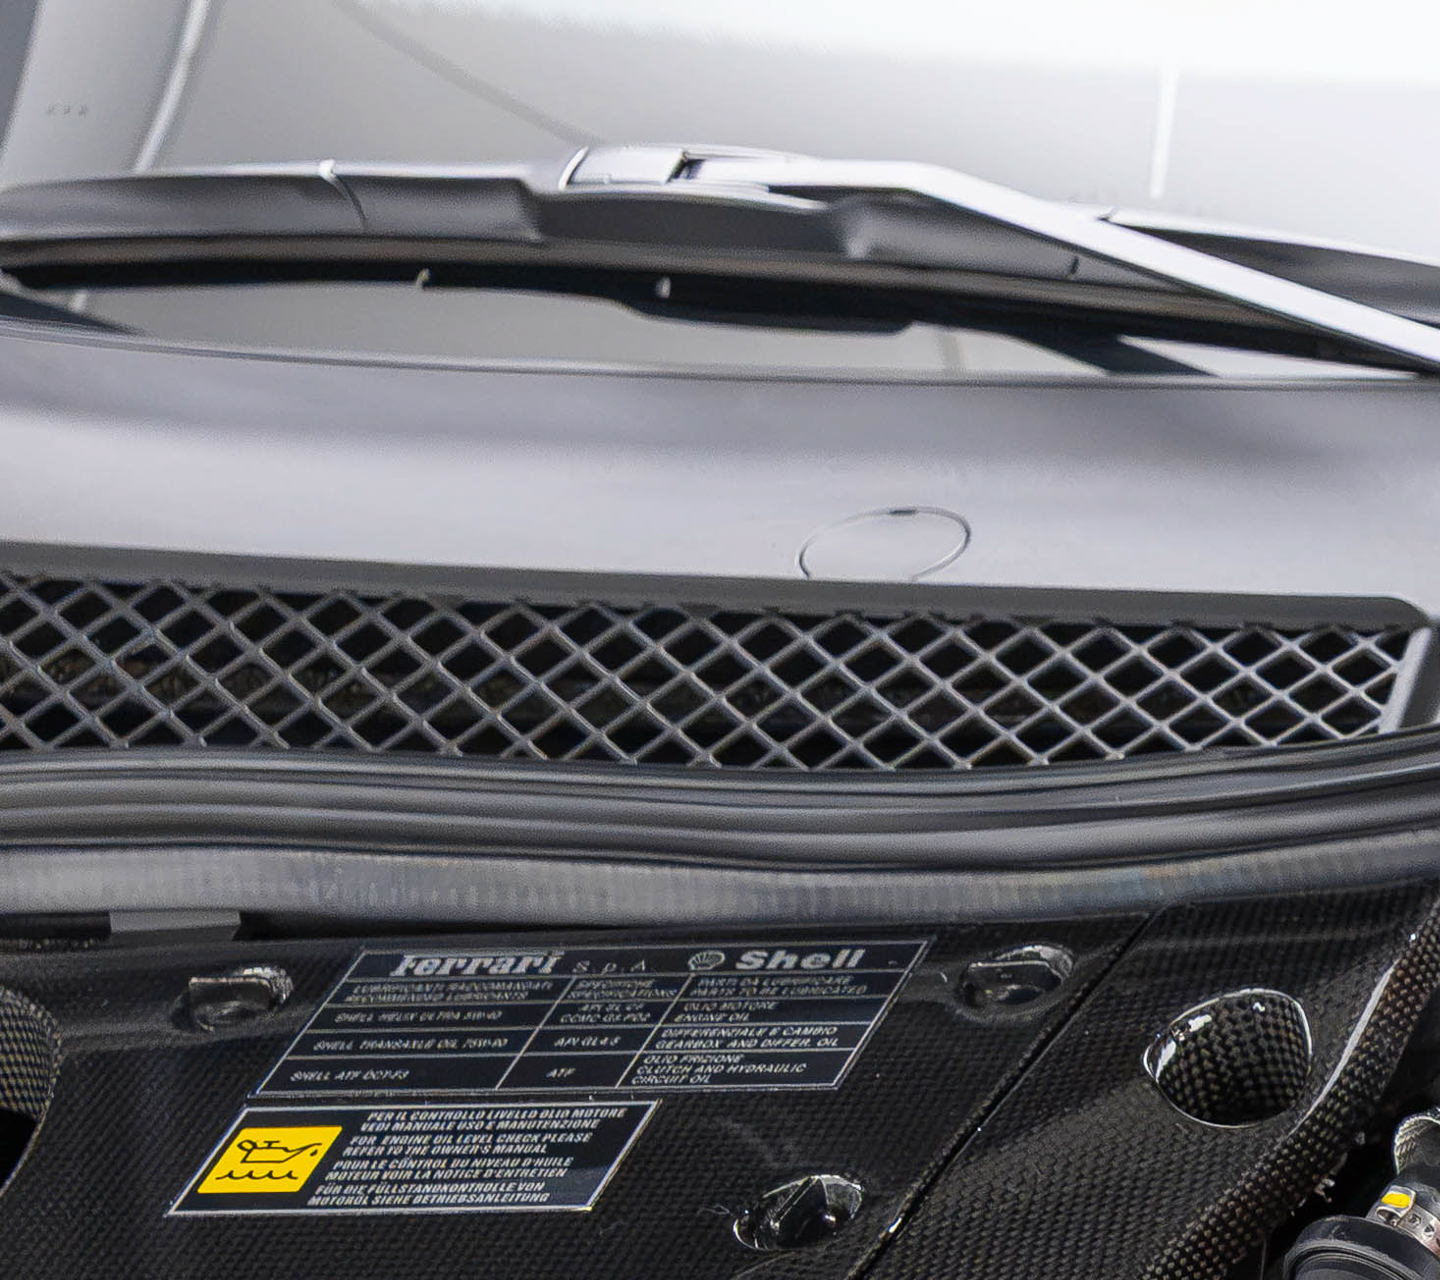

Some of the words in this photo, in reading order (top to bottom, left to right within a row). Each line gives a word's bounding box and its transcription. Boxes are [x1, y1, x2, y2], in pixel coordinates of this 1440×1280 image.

[388, 950, 566, 976] Ferrari
[736, 949, 866, 970] Shell
[816, 1037, 839, 1047] OIL
[696, 1063, 725, 1074] AND
[688, 1074, 711, 1084] OIL
[367, 1111, 395, 1121] PER
[409, 1109, 487, 1121] CONTROLLO
[486, 1109, 542, 1120] LIVELLO
[538, 1108, 571, 1120] OLIO
[571, 1107, 628, 1119] MOTORE
[360, 1122, 392, 1132] VEDI
[391, 1121, 457, 1132] MANUALE
[456, 1120, 487, 1131] USO
[496, 1119, 601, 1130] MANUTENZIONE
[350, 1135, 377, 1146] FOR
[381, 1134, 432, 1145] ENGINE
[432, 1134, 454, 1145] OIL
[456, 1133, 494, 1144] LEVEL
[496, 1133, 542, 1143] CHECK
[541, 1132, 593, 1143] PLEASE
[342, 1146, 385, 1157] REFER
[386, 1146, 404, 1156] TO
[403, 1146, 430, 1156] THE
[491, 1143, 547, 1154] MANUAL
[333, 1159, 370, 1171] POUR
[370, 1159, 388, 1170] LE
[450, 1157, 468, 1168] DU
[470, 1156, 520, 1168] NIVEAU
[324, 1170, 381, 1182] MOTEUR
[380, 1169, 414, 1181] VOIR
[413, 1169, 432, 1180] LA
[432, 1168, 483, 1180] NOTICE
[482, 1168, 569, 1179] D'ENTRETIEN
[314, 1182, 343, 1195] FÜR
[343, 1184, 368, 1195] DIE
[367, 1181, 518, 1195] FÜLLSTANDKONTROLLE
[516, 1181, 546, 1192] VON
[371, 1194, 411, 1205] SIEHE
[411, 1192, 551, 1205] BETRIEBSANLEITUNG
